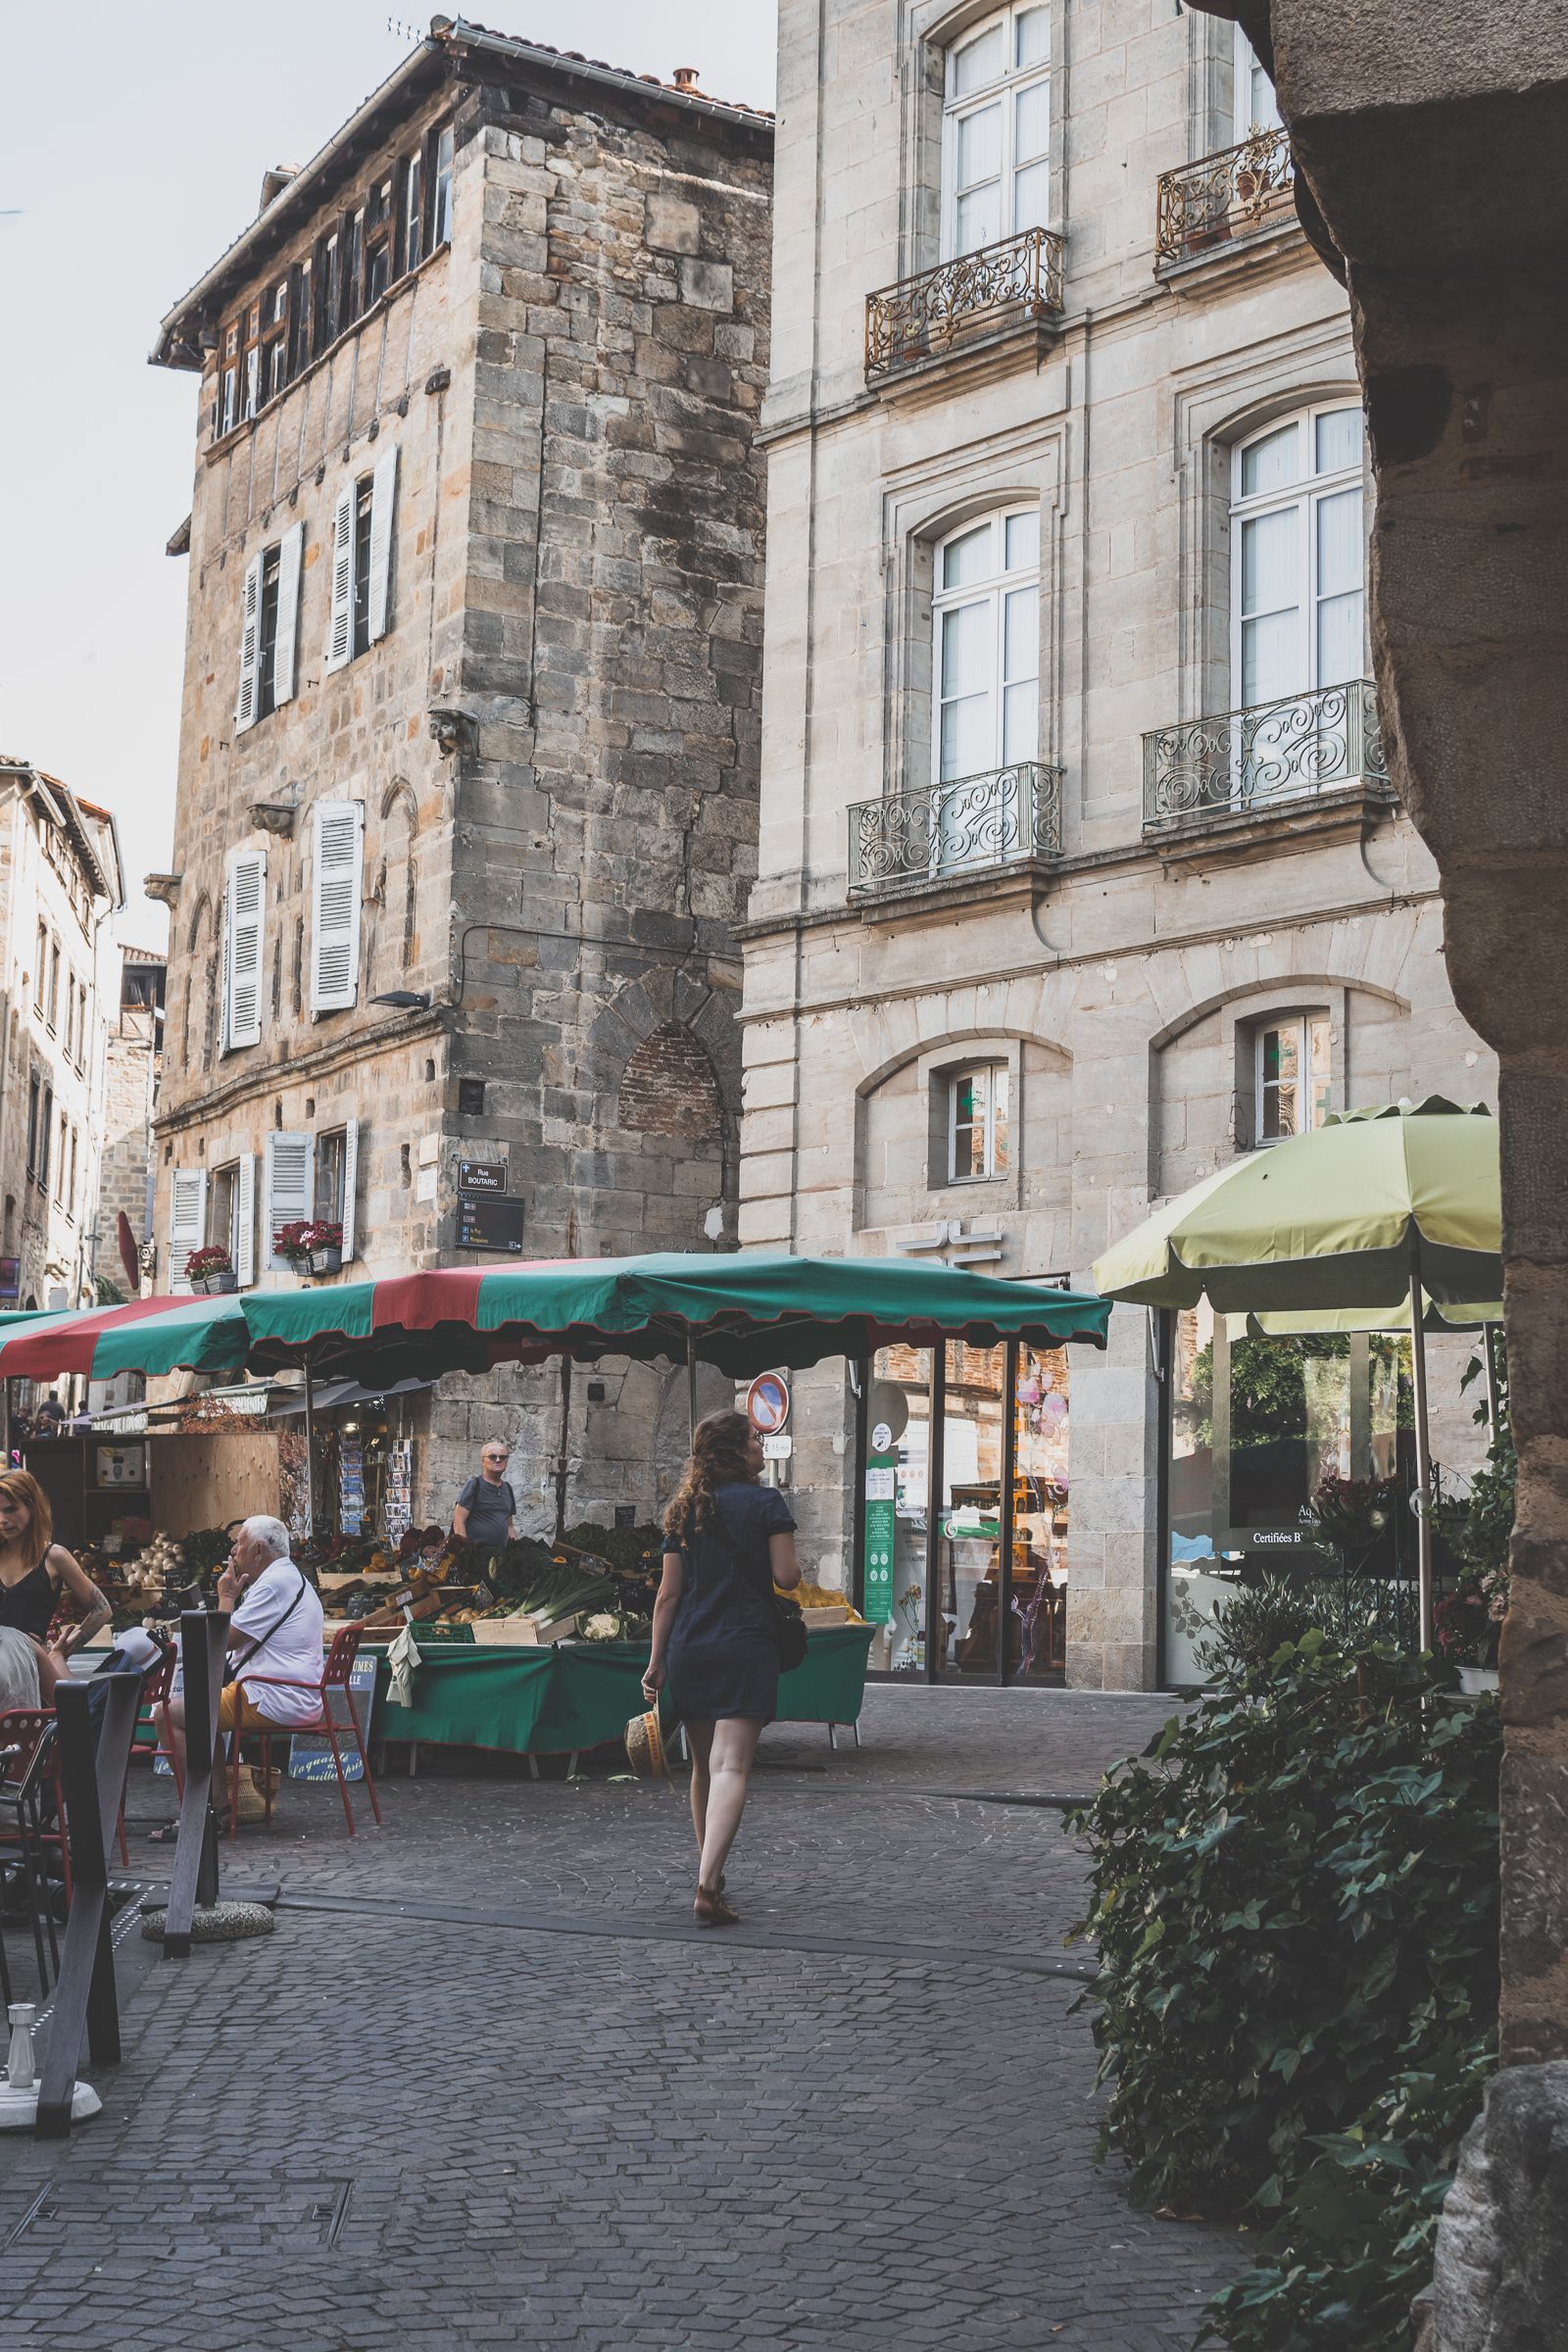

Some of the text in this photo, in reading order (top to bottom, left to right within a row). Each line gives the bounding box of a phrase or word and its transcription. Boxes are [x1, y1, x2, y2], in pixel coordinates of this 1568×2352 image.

[477, 1168, 489, 1177] Rue
[467, 1177, 498, 1187] BOUTARIC
[1298, 1504, 1315, 1519] Aq
[1253, 1532, 1303, 1544] Certifiées B
[353, 1660, 373, 1673] UMES
[349, 1675, 361, 1686] LLE
